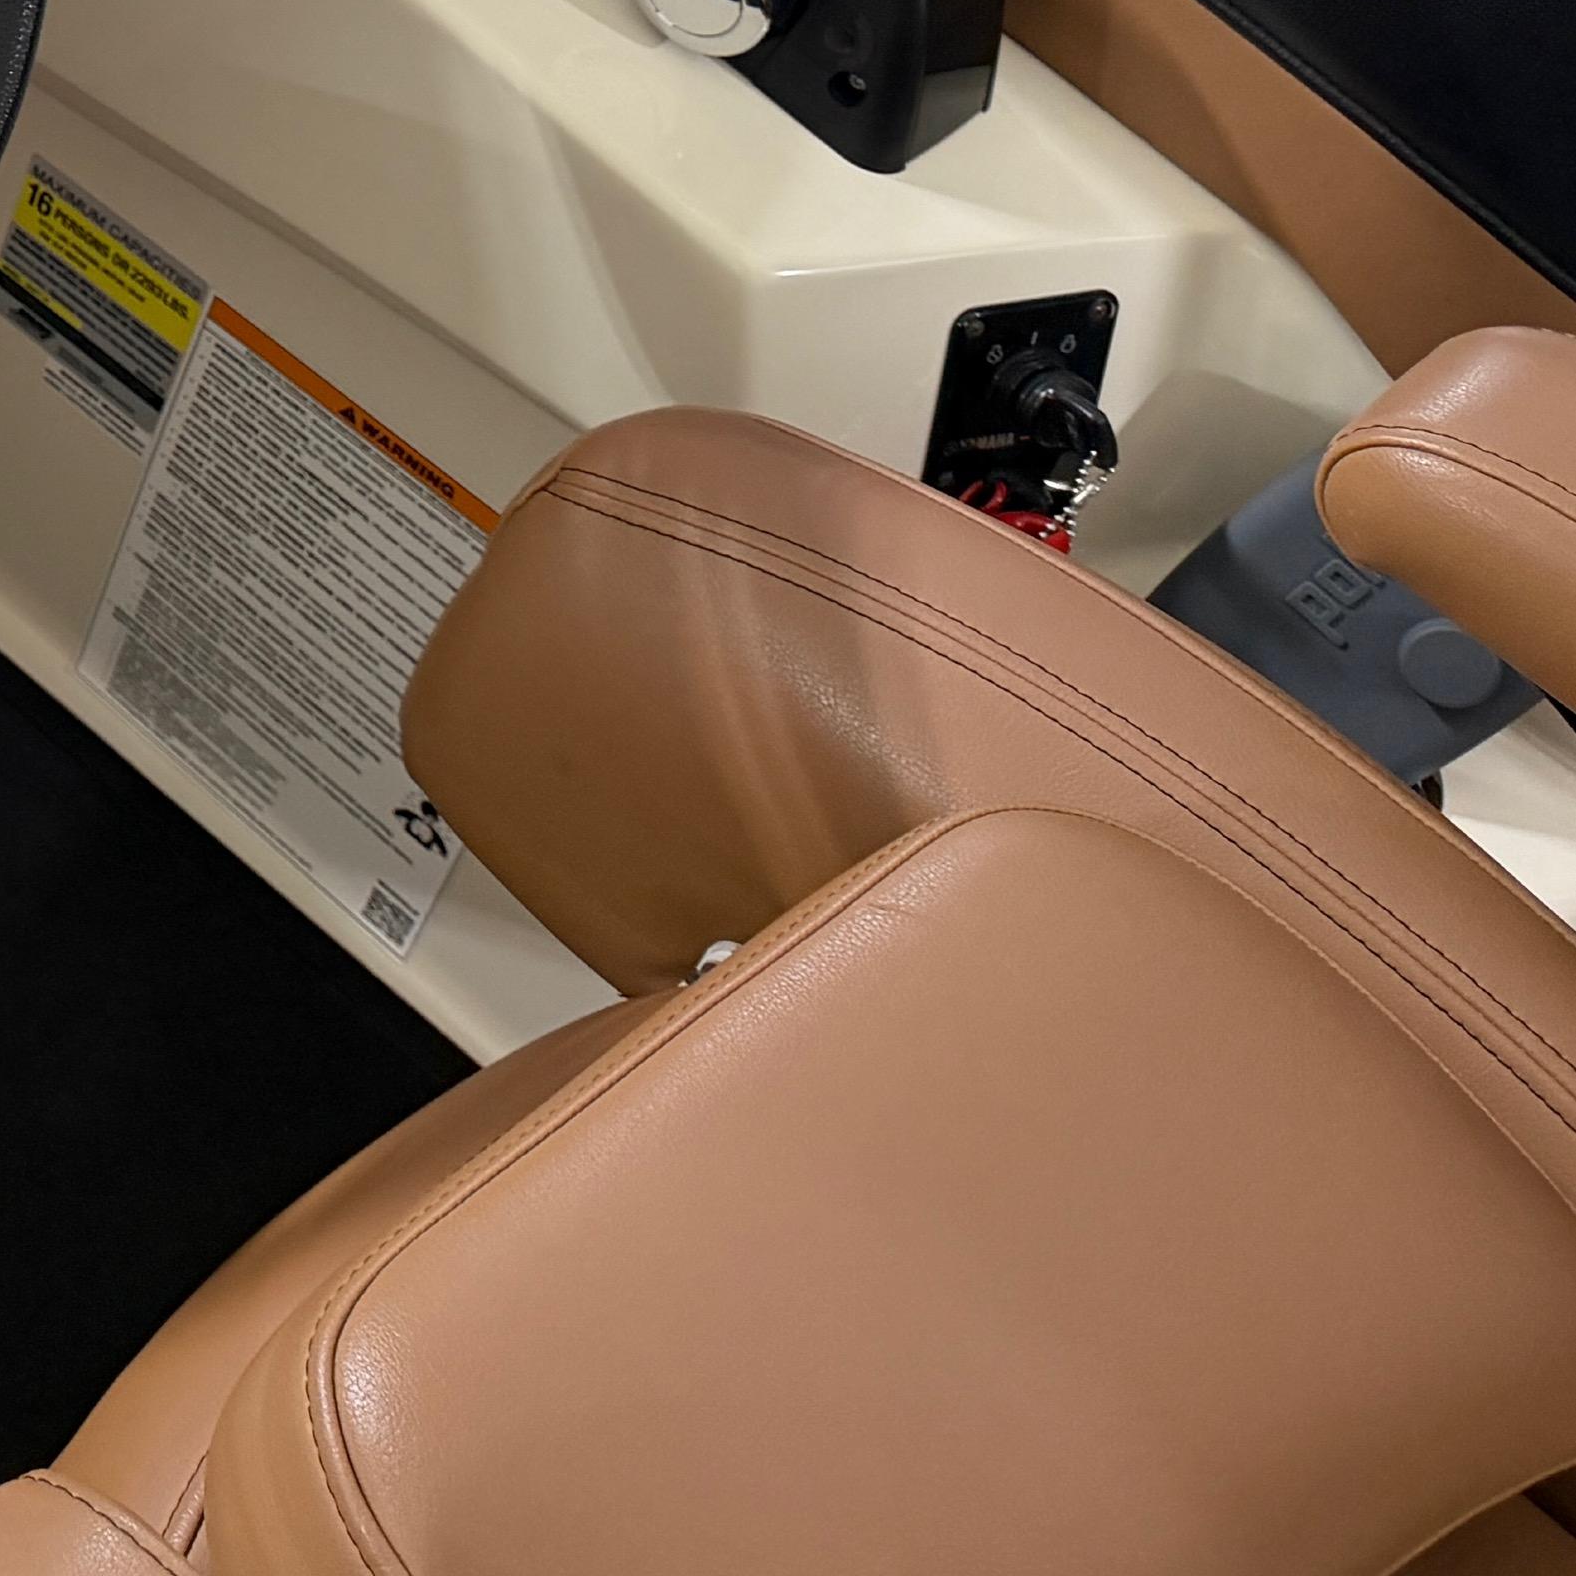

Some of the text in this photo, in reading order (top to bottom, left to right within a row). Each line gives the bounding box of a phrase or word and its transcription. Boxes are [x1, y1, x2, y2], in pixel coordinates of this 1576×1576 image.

[23, 179, 55, 218] 16
[52, 207, 111, 259] PERSONS
[359, 418, 456, 502] WARNING
